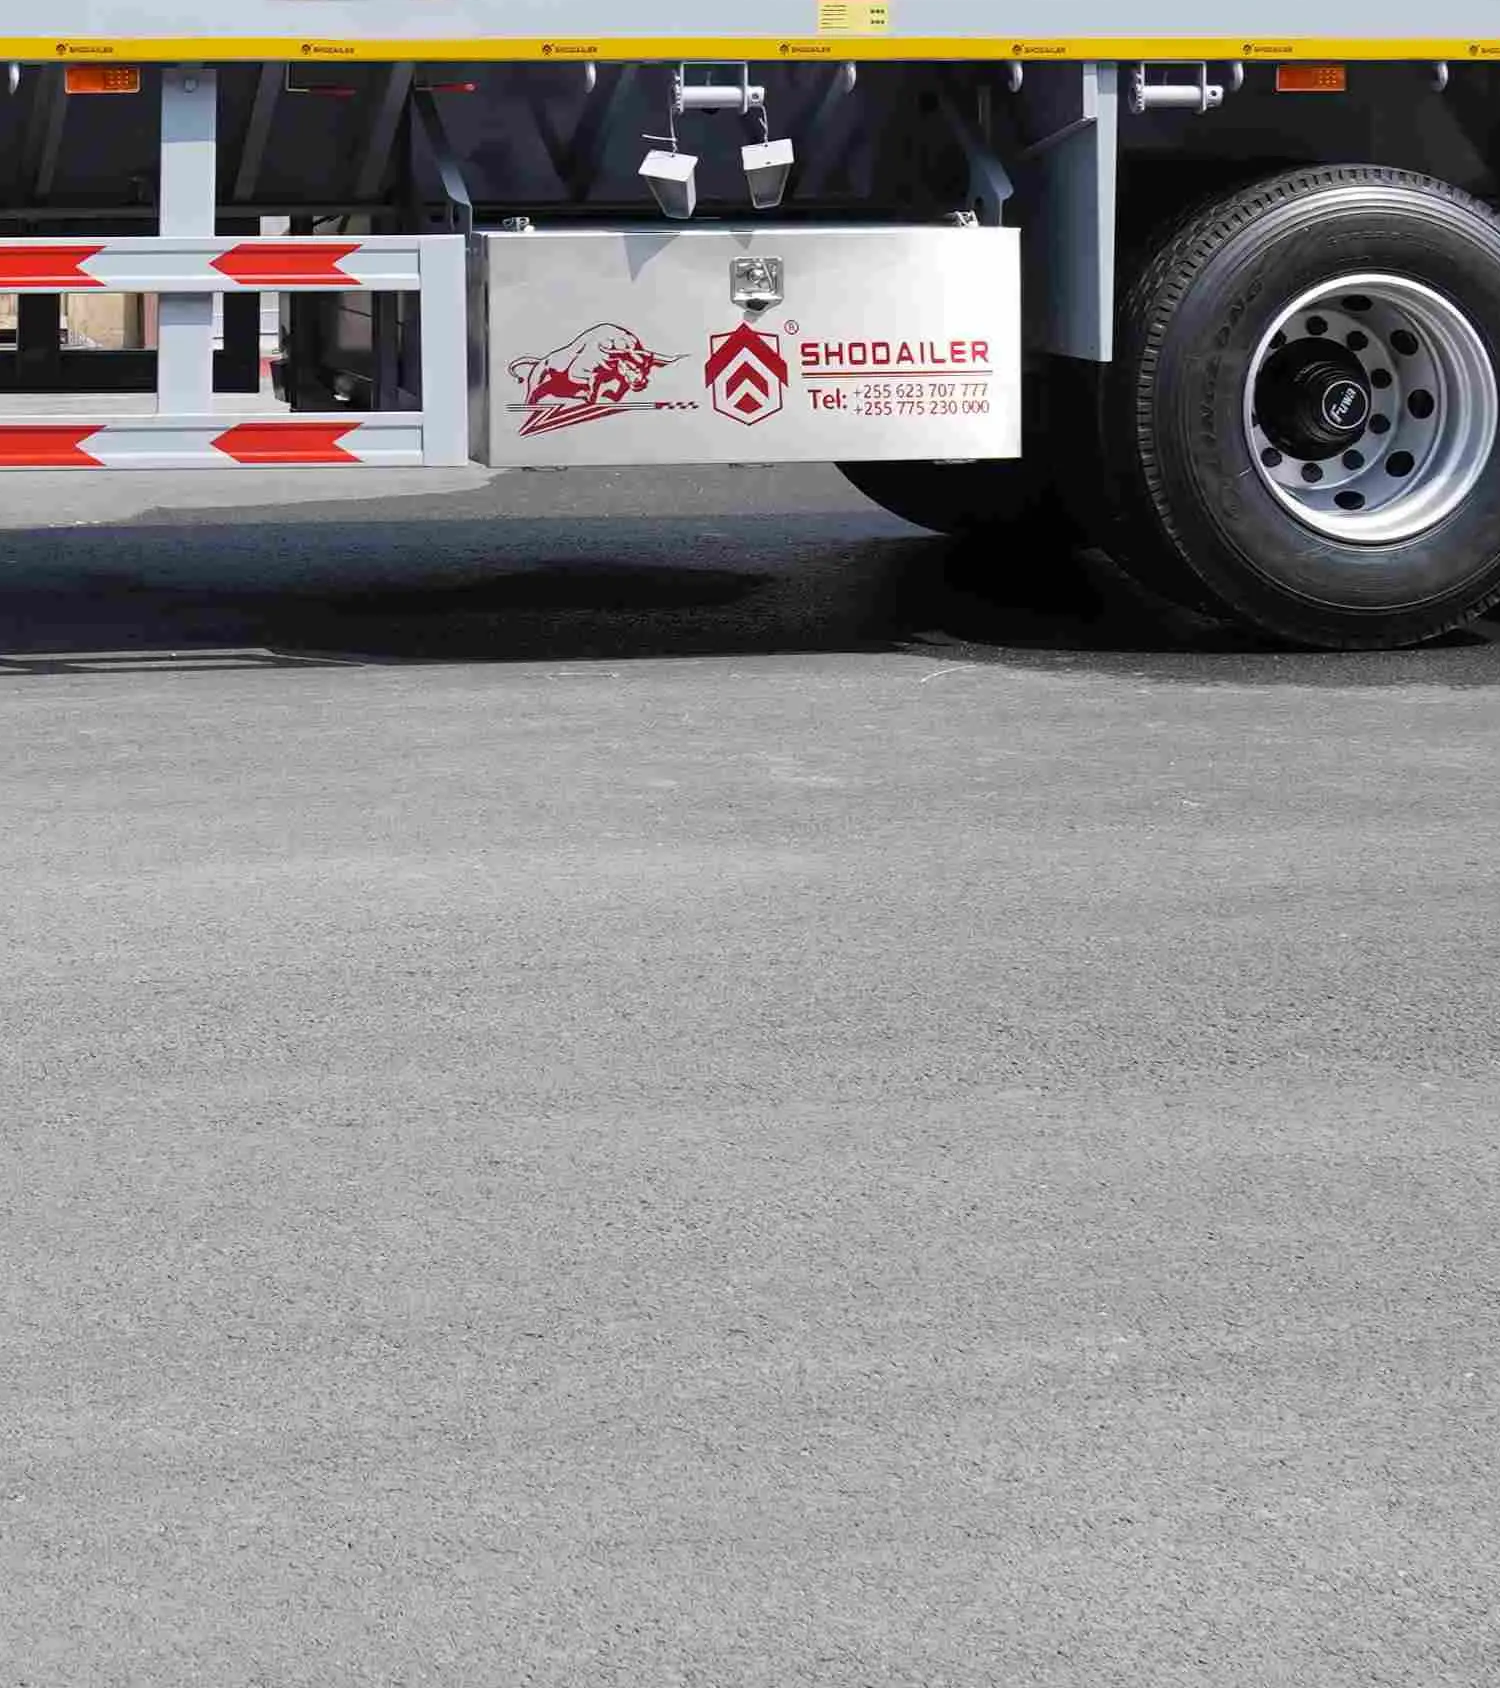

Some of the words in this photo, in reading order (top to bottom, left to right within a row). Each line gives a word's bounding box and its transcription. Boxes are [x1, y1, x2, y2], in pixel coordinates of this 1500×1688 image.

[800, 341, 989, 366] SHODAILER
[807, 388, 848, 410] Tel:
[854, 383, 891, 399] +255
[895, 383, 924, 398] 623
[928, 383, 956, 398] 707
[962, 383, 988, 397] 777
[854, 400, 892, 416] +255
[899, 400, 925, 416] 775
[930, 400, 958, 414] 230
[962, 400, 989, 414] 000
[1329, 387, 1357, 424] Fuwa
